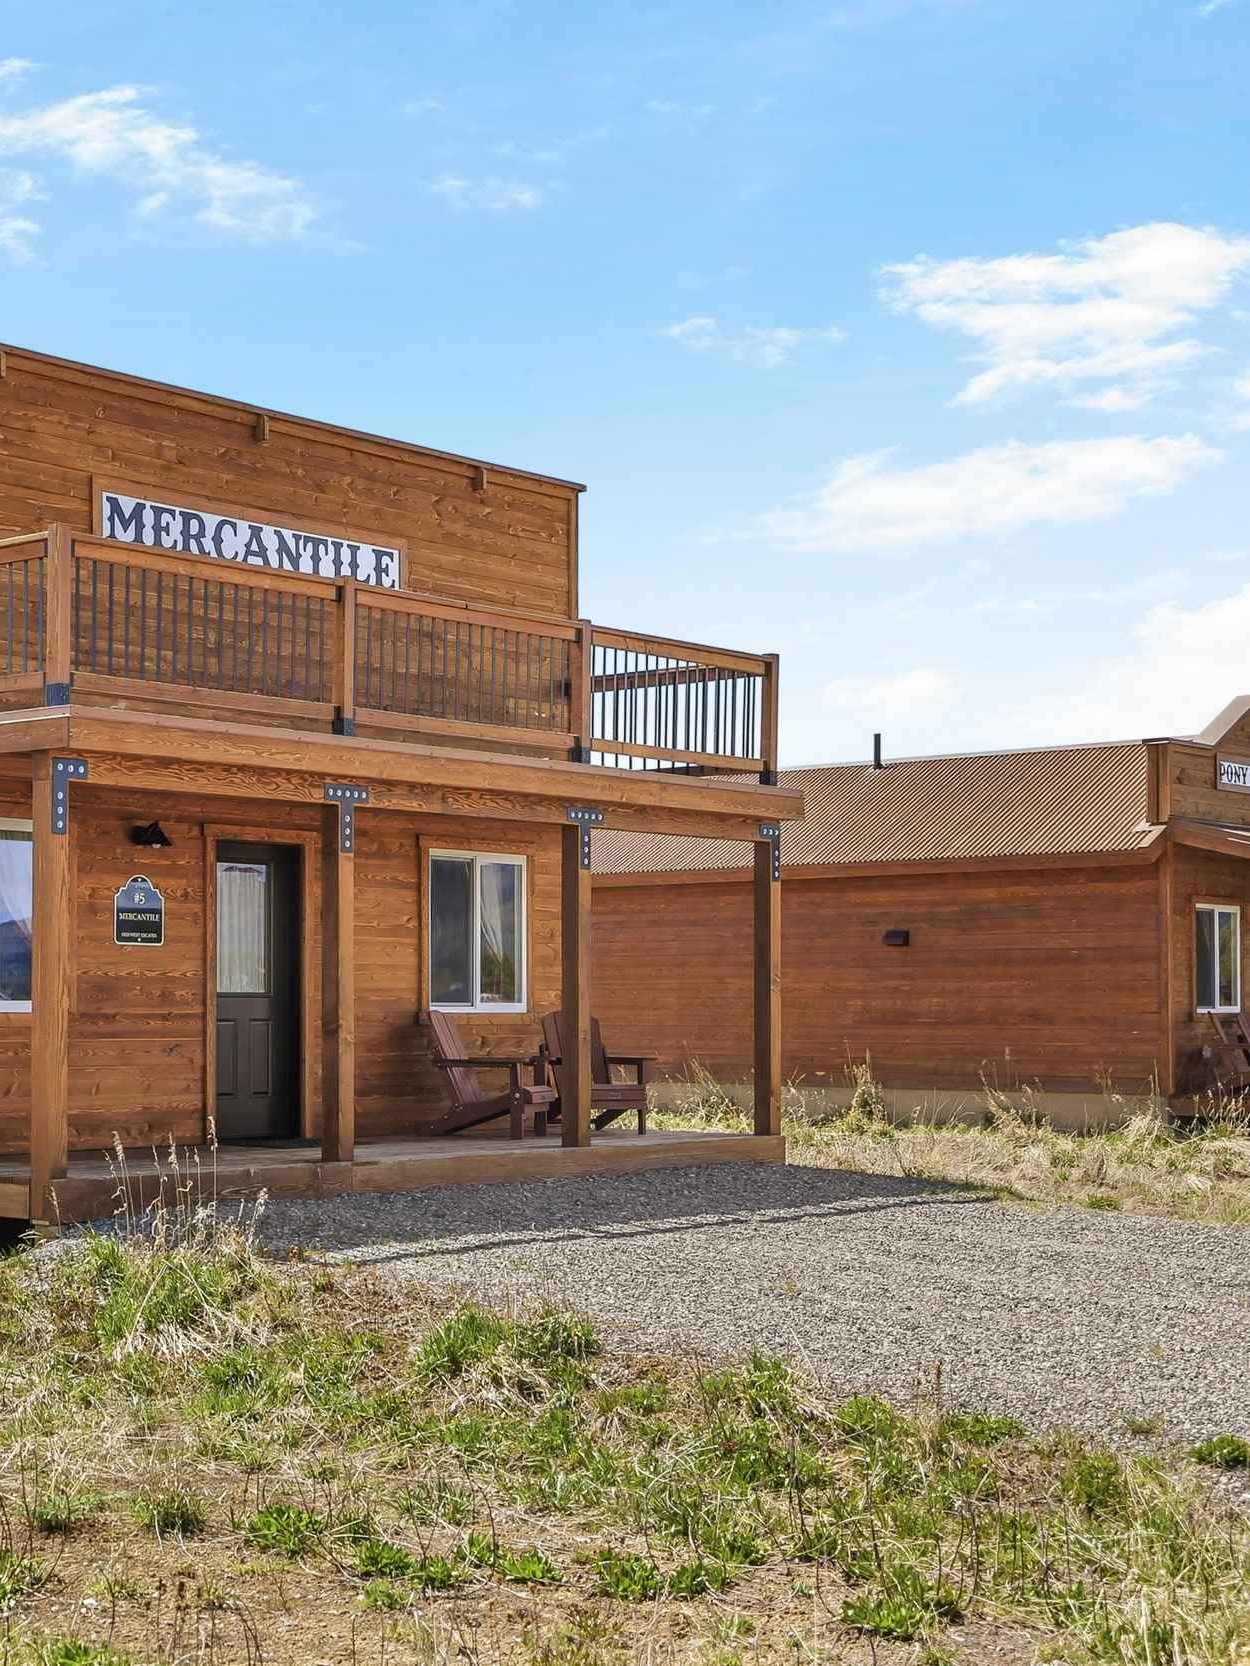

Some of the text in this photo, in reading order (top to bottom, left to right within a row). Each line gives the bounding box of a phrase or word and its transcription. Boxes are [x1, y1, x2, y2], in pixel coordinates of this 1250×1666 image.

[105, 496, 396, 589] MERCANTILE
[1220, 763, 1248, 784] PONY
[133, 893, 146, 905] #5
[119, 912, 160, 922] MERCANTILE
